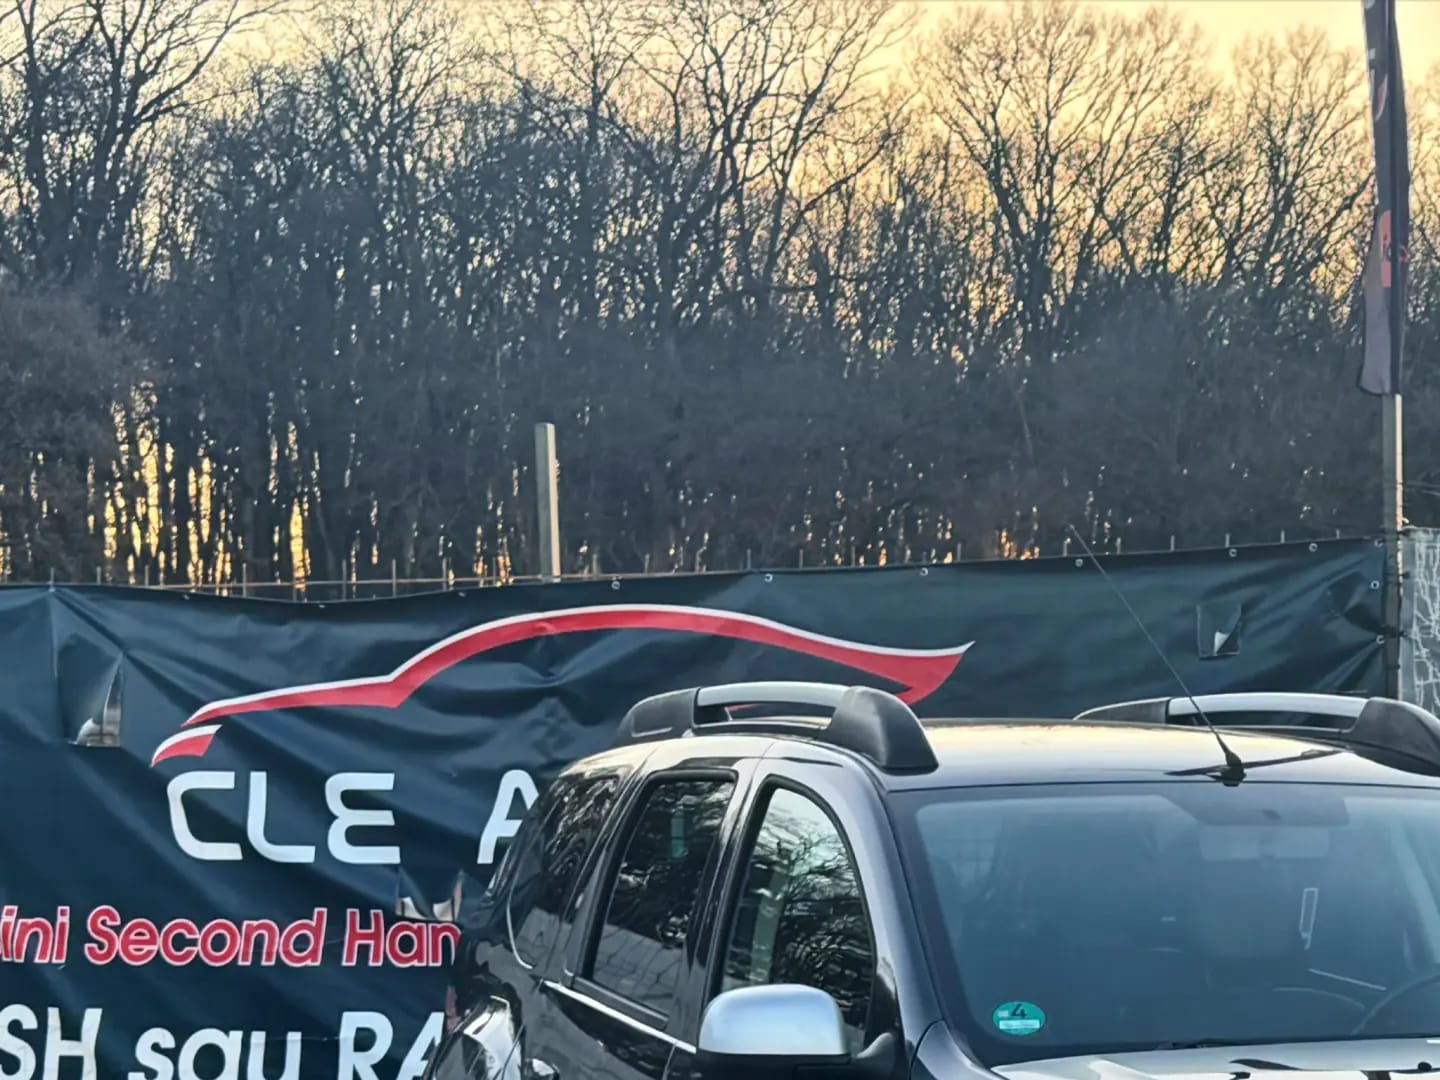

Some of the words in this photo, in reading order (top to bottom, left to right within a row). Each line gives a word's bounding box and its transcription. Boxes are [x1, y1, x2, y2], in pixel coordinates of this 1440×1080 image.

[166, 770, 400, 865] CLE
[477, 769, 540, 865] A
[0, 904, 70, 964] ini
[84, 905, 327, 967] Second
[342, 908, 462, 967] Han
[1011, 1003, 1028, 1018] 4
